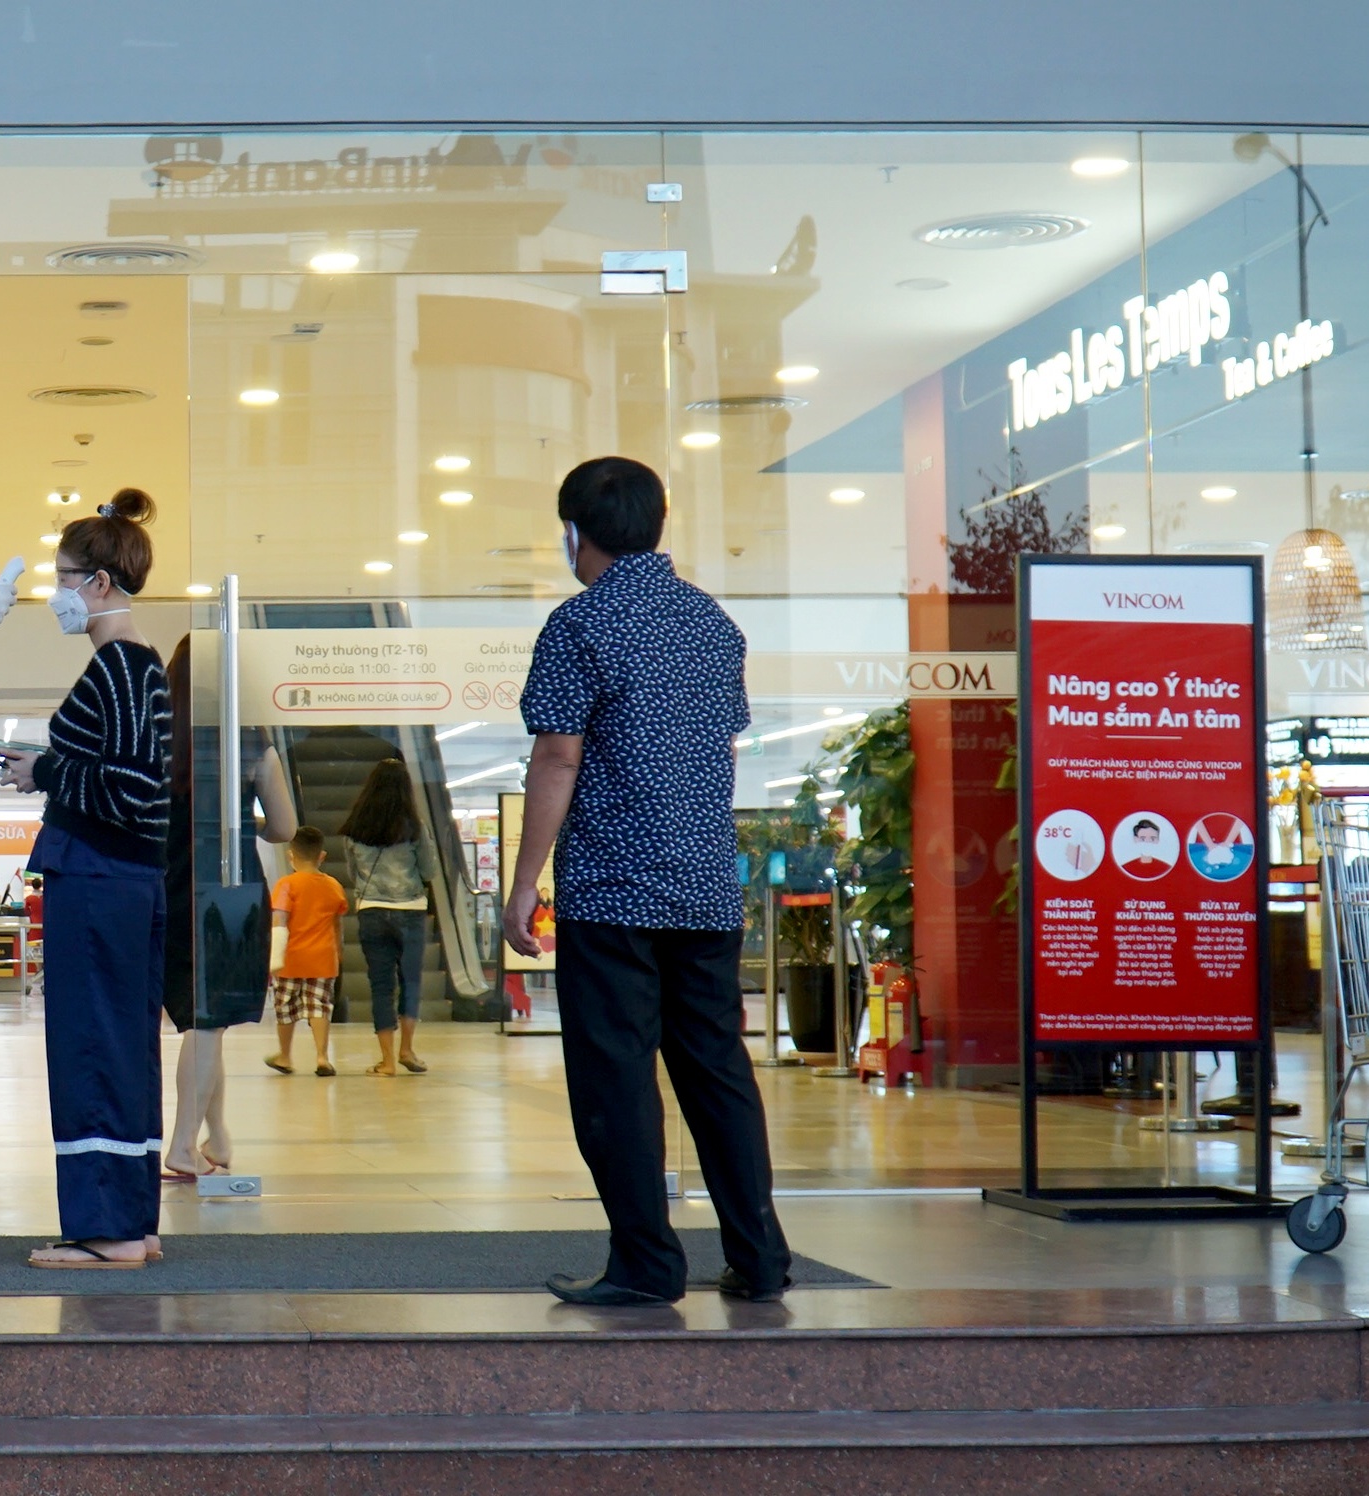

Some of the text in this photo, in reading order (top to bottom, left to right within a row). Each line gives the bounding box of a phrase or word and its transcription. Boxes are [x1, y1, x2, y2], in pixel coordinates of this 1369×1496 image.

[1008, 271, 1231, 432] Tous Les Temps
[1256, 341, 1274, 386] &
[1103, 593, 1184, 609] VINCOM
[295, 645, 329, 658] Ngày
[382, 644, 428, 657] (T2-T6)
[479, 641, 534, 654] Cuối tuầ
[360, 663, 391, 674] 11:00
[403, 662, 436, 674] 21:00
[836, 661, 996, 690] VINCOM
[1299, 658, 1369, 689] VIN
[1048, 672, 1240, 701] Nâng cao Ý thức
[317, 692, 355, 702] KHÔNG
[1048, 702, 1241, 729] Mua sắm An tâm
[1047, 757, 1242, 770] QUÝ KHÁCH HÀNG VUI LÒNG CÙNG VINCOM
[1064, 769, 1226, 781] THỰC HIỆN CÁC BIỆN PHÁP AN TOÀN
